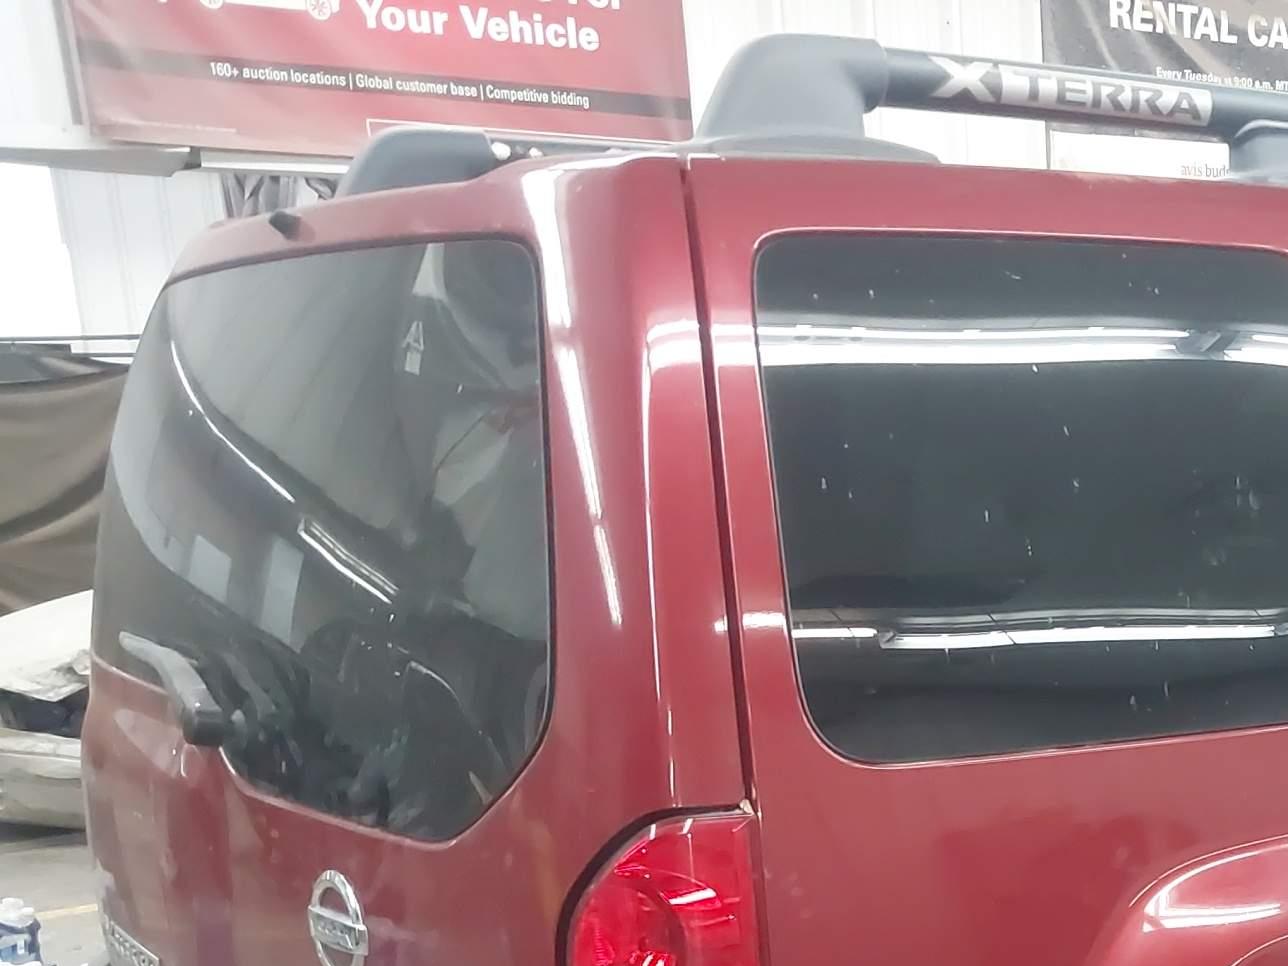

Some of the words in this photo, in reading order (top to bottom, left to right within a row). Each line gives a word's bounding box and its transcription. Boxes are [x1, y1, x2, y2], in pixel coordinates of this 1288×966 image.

[358, 0, 449, 35] Your
[458, 4, 600, 52] Vehicle
[1109, 0, 1238, 44] RENTAL
[210, 61, 239, 77] 160+
[242, 66, 288, 82] auction
[290, 69, 346, 87] locations
[355, 73, 393, 90] Global
[396, 79, 447, 94] customer
[450, 82, 477, 98] base
[486, 84, 549, 104] Competitive
[551, 91, 590, 109] bidding
[927, 55, 1204, 121] XTERRA
[1155, 66, 1182, 81] Every
[1233, 76, 1253, 88] 9:00
[1180, 162, 1203, 177] avis
